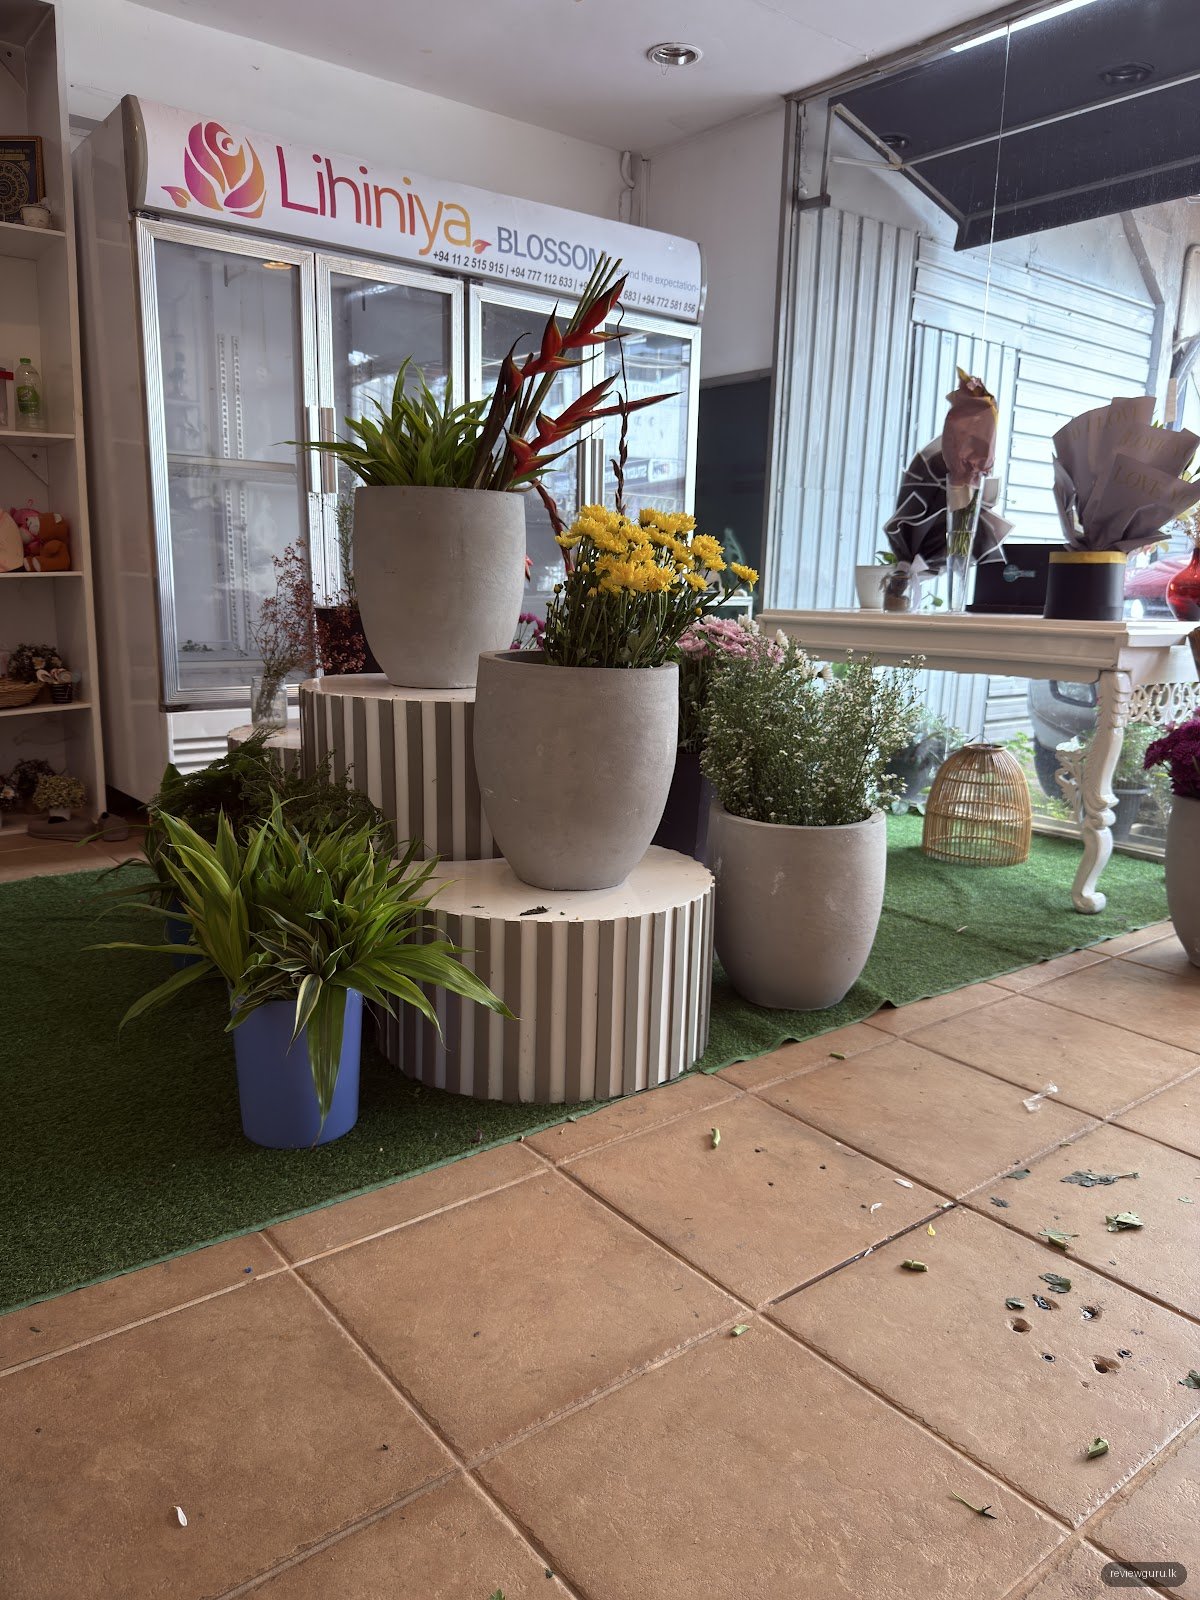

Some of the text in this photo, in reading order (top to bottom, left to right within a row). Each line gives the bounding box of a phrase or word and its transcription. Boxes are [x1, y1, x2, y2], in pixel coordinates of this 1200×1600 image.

[276, 145, 471, 256] Lihiniya
[433, 250, 449, 263] +94
[452, 254, 461, 265] 11
[463, 256, 469, 267] 2
[471, 257, 487, 271] 515
[489, 261, 504, 274] 915
[510, 267, 525, 278] +94
[527, 269, 542, 281] 777
[544, 273, 557, 285] 112
[558, 276, 573, 288] 633
[623, 290, 637, 302] 683
[642, 294, 655, 305] +94
[656, 297, 669, 308] 772
[669, 300, 682, 311] 581
[683, 302, 696, 313] 856
[641, 271, 653, 283] the
